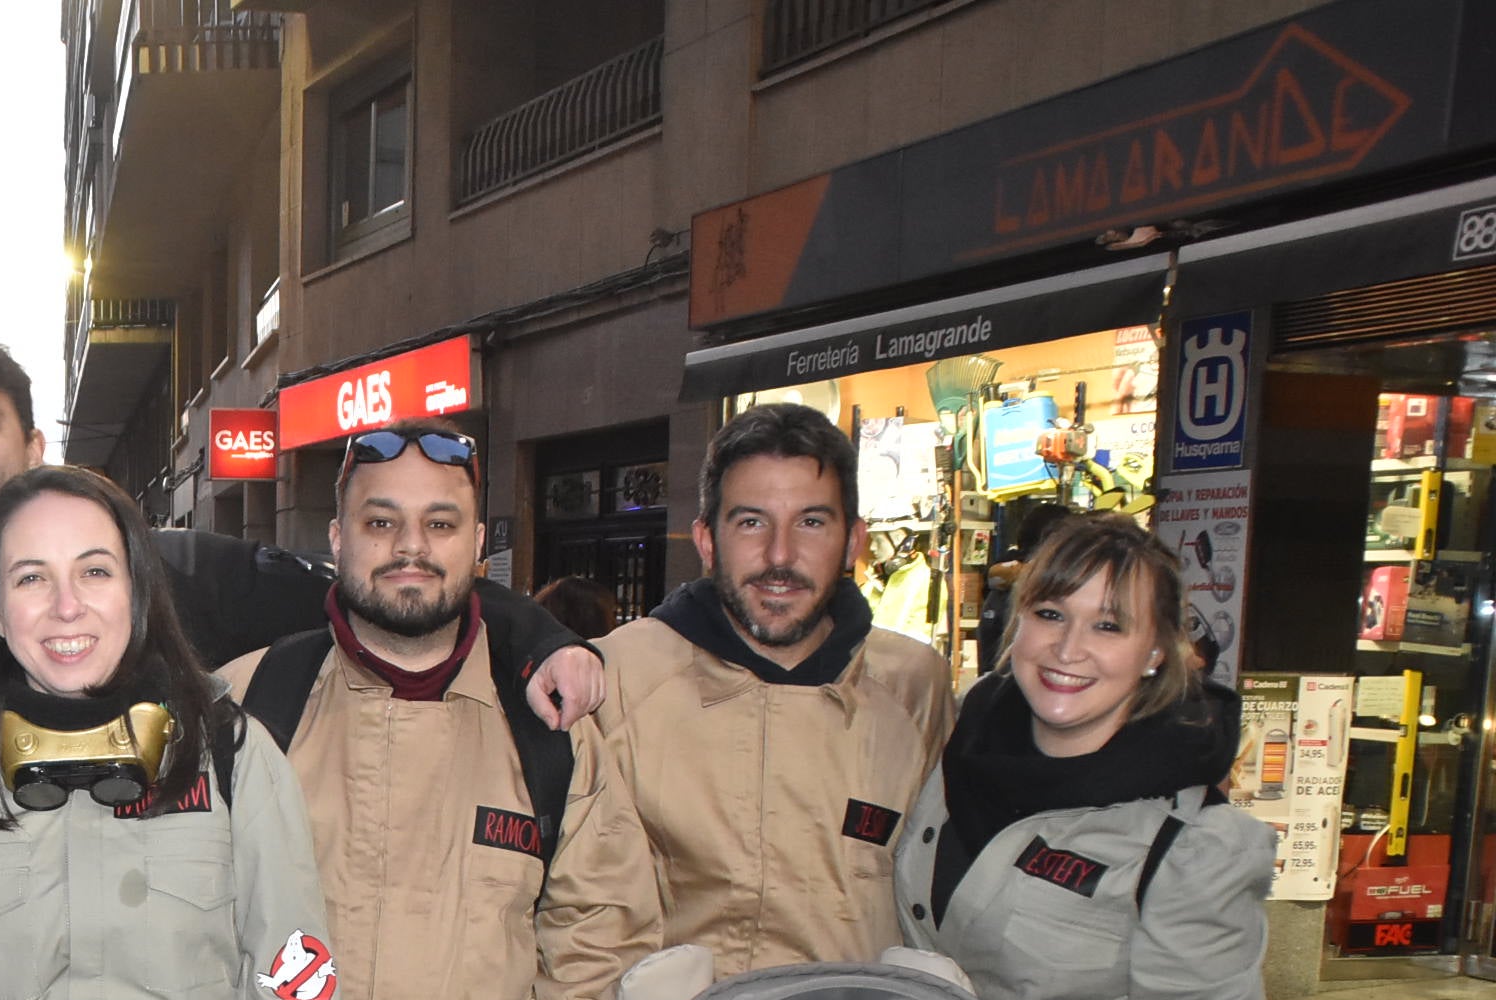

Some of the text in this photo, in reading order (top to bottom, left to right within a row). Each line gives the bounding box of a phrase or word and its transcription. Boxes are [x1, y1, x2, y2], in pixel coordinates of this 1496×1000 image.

[787, 314, 992, 376] Ferretería Lamagrande
[337, 370, 392, 431] GAES
[215, 430, 274, 451] GAES
[1175, 440, 1241, 459] Husqvarna
[1242, 701, 1299, 711] DE CUARZO
[1296, 785, 1312, 796] DE
[1388, 885, 1432, 895] FUEL
